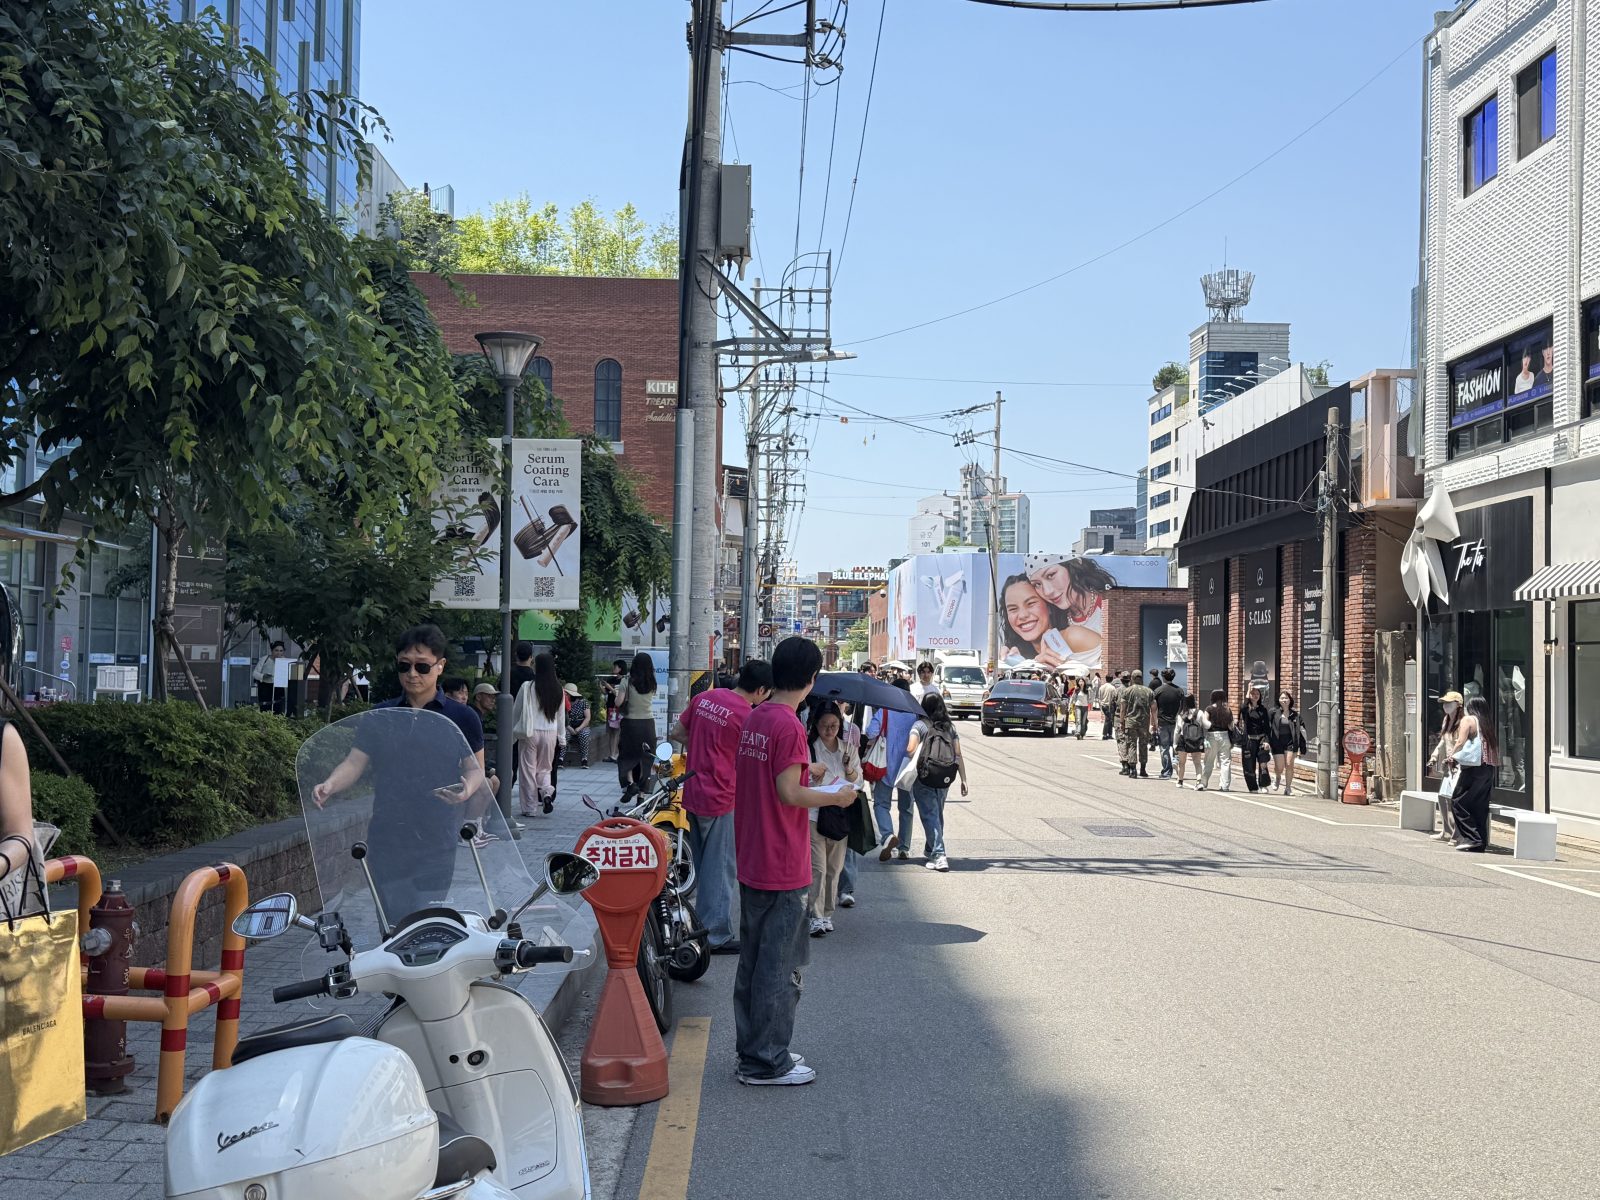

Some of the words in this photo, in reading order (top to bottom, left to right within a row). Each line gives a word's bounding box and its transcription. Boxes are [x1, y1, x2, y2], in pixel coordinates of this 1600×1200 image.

[647, 382, 676, 393] KITH
[1457, 366, 1502, 406] FASHION
[645, 397, 676, 406] TREATS
[527, 453, 565, 464] Serum
[523, 464, 570, 478] Coating
[453, 475, 480, 485] Cara
[532, 476, 560, 487] Cara
[832, 571, 853, 580] BLUE
[1202, 613, 1221, 627] STUDIO
[1248, 609, 1272, 626] S-CLASS
[928, 637, 960, 645] TOCOBO
[698, 698, 734, 719] BEAUTY
[586, 845, 650, 868] 주차금지
[22, 1019, 57, 1036] BALENCIAGA
[217, 1121, 279, 1153] Vespa
